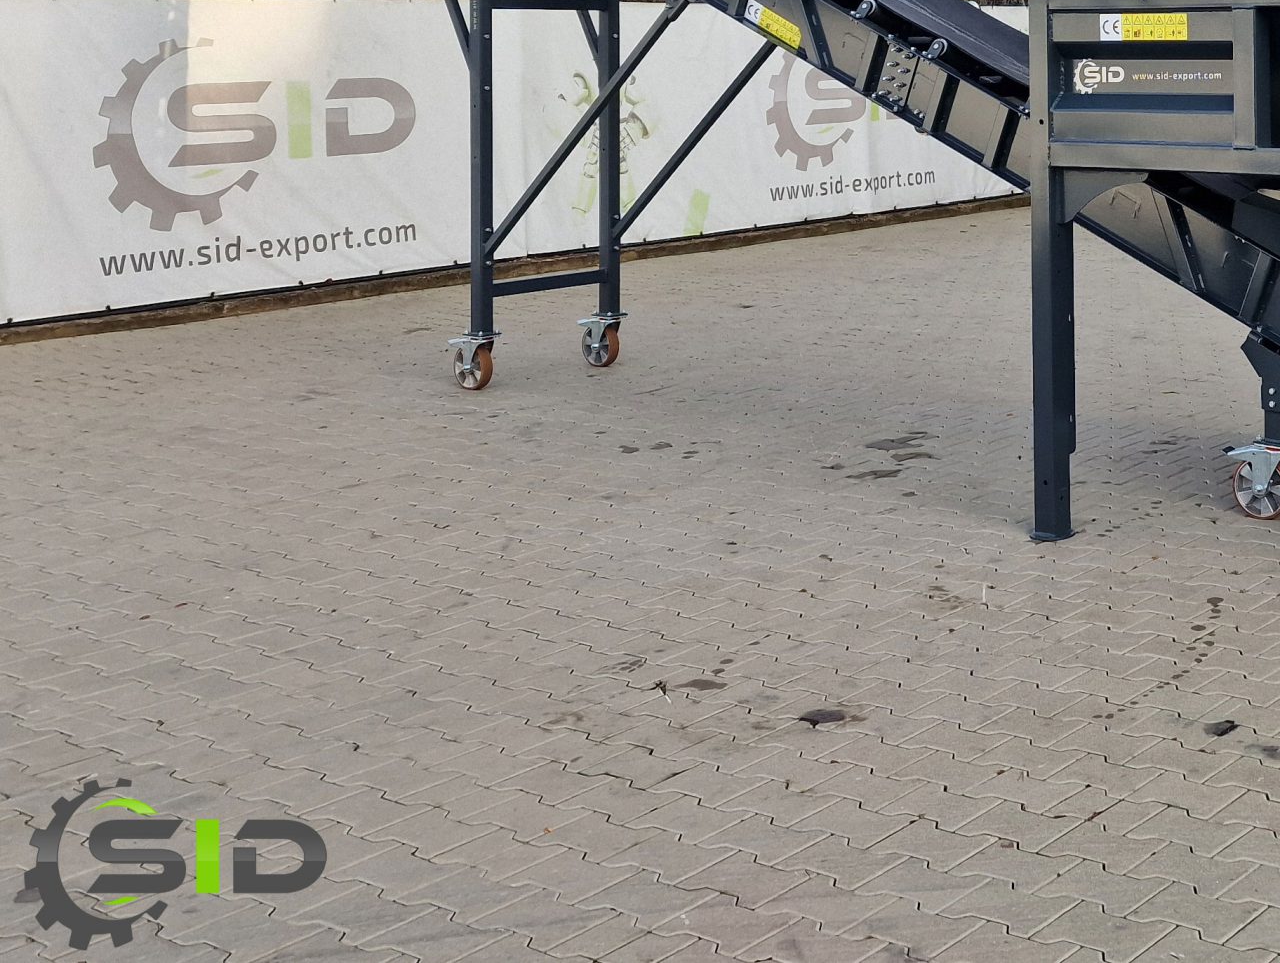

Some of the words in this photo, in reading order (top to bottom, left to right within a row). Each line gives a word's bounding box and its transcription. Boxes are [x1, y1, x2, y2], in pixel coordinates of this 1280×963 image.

[1083, 66, 1125, 84] SID
[1132, 71, 1222, 81] www.sid-export.com
[166, 77, 417, 168] SID
[769, 169, 936, 202] www.sid-export.com
[99, 223, 418, 277] www.sid-export.com
